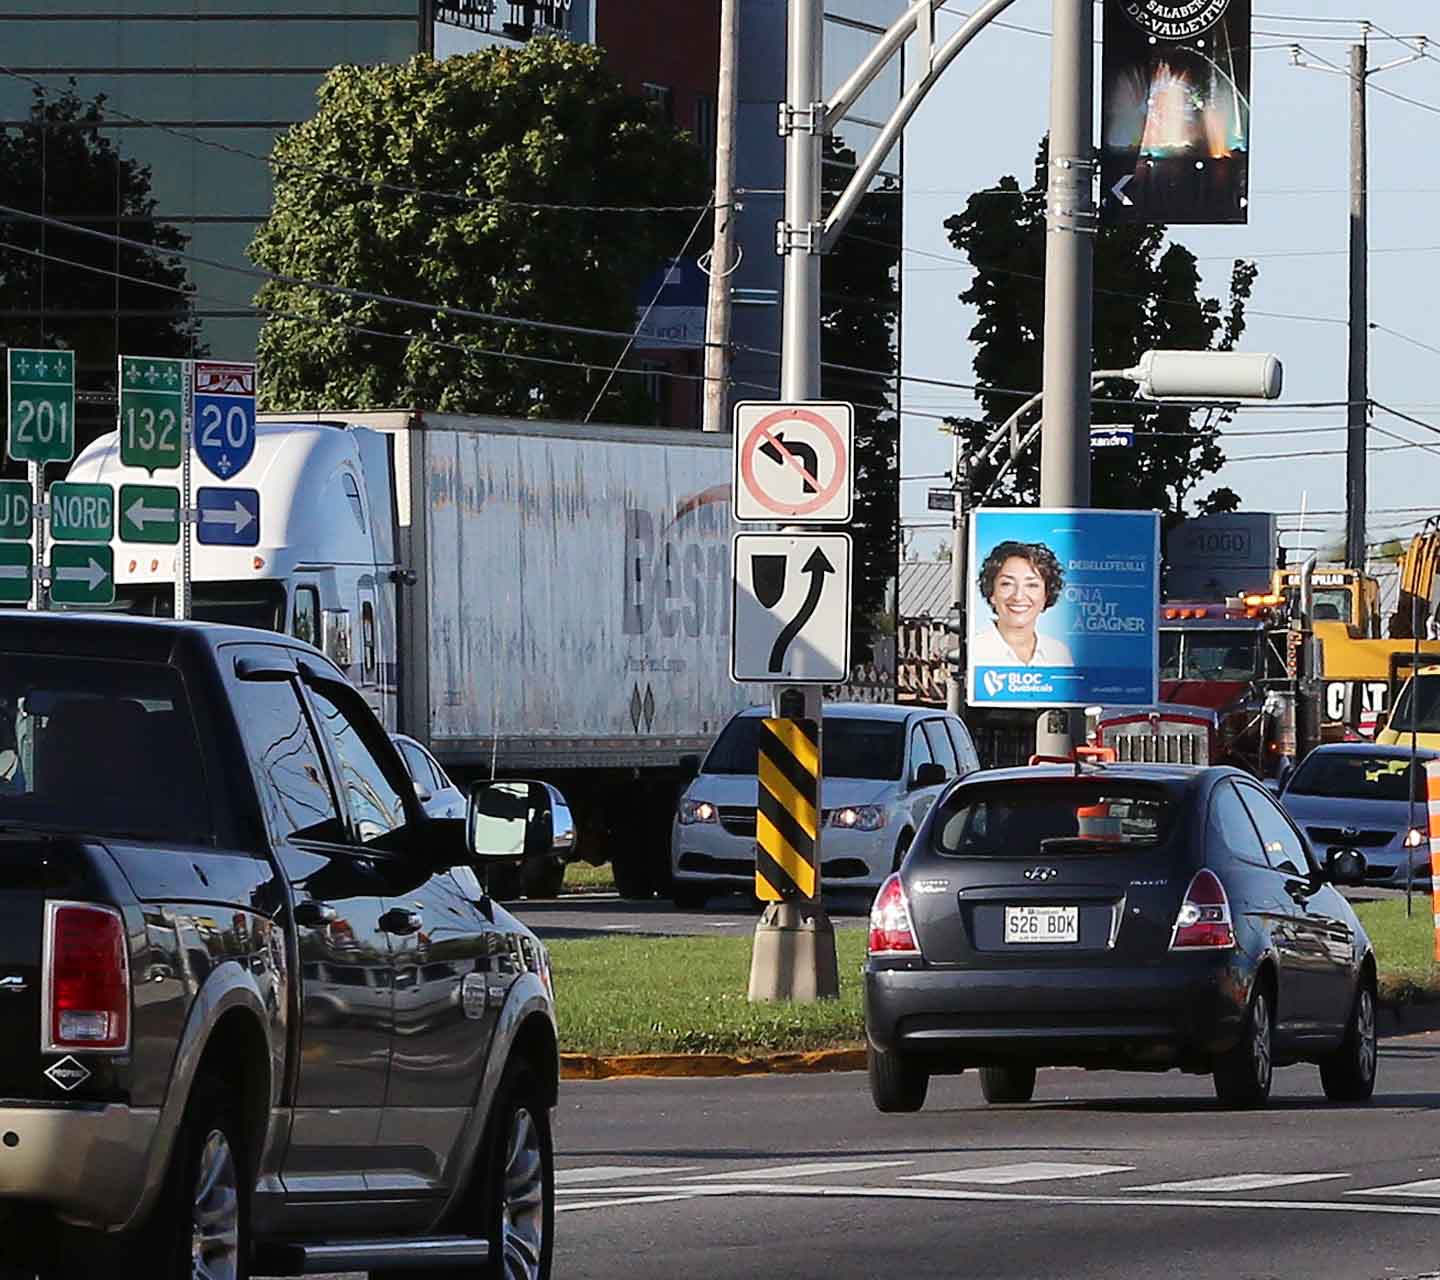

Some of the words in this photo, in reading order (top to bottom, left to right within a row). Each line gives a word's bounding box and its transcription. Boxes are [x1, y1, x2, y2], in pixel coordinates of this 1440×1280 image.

[17, 399, 67, 443] 201
[201, 405, 248, 448] 20
[127, 407, 176, 451] 132
[1090, 434, 1128, 447] xandre
[53, 495, 110, 529] NORD
[1288, 574, 1345, 585] CAPILLAR
[1065, 587, 1090, 602] ON
[1081, 602, 1118, 616] TOUT
[1087, 618, 1146, 632] GAGNER
[1009, 672, 1043, 685] BLOC
[1009, 915, 1038, 934] S26
[1047, 915, 1076, 934] BDK
